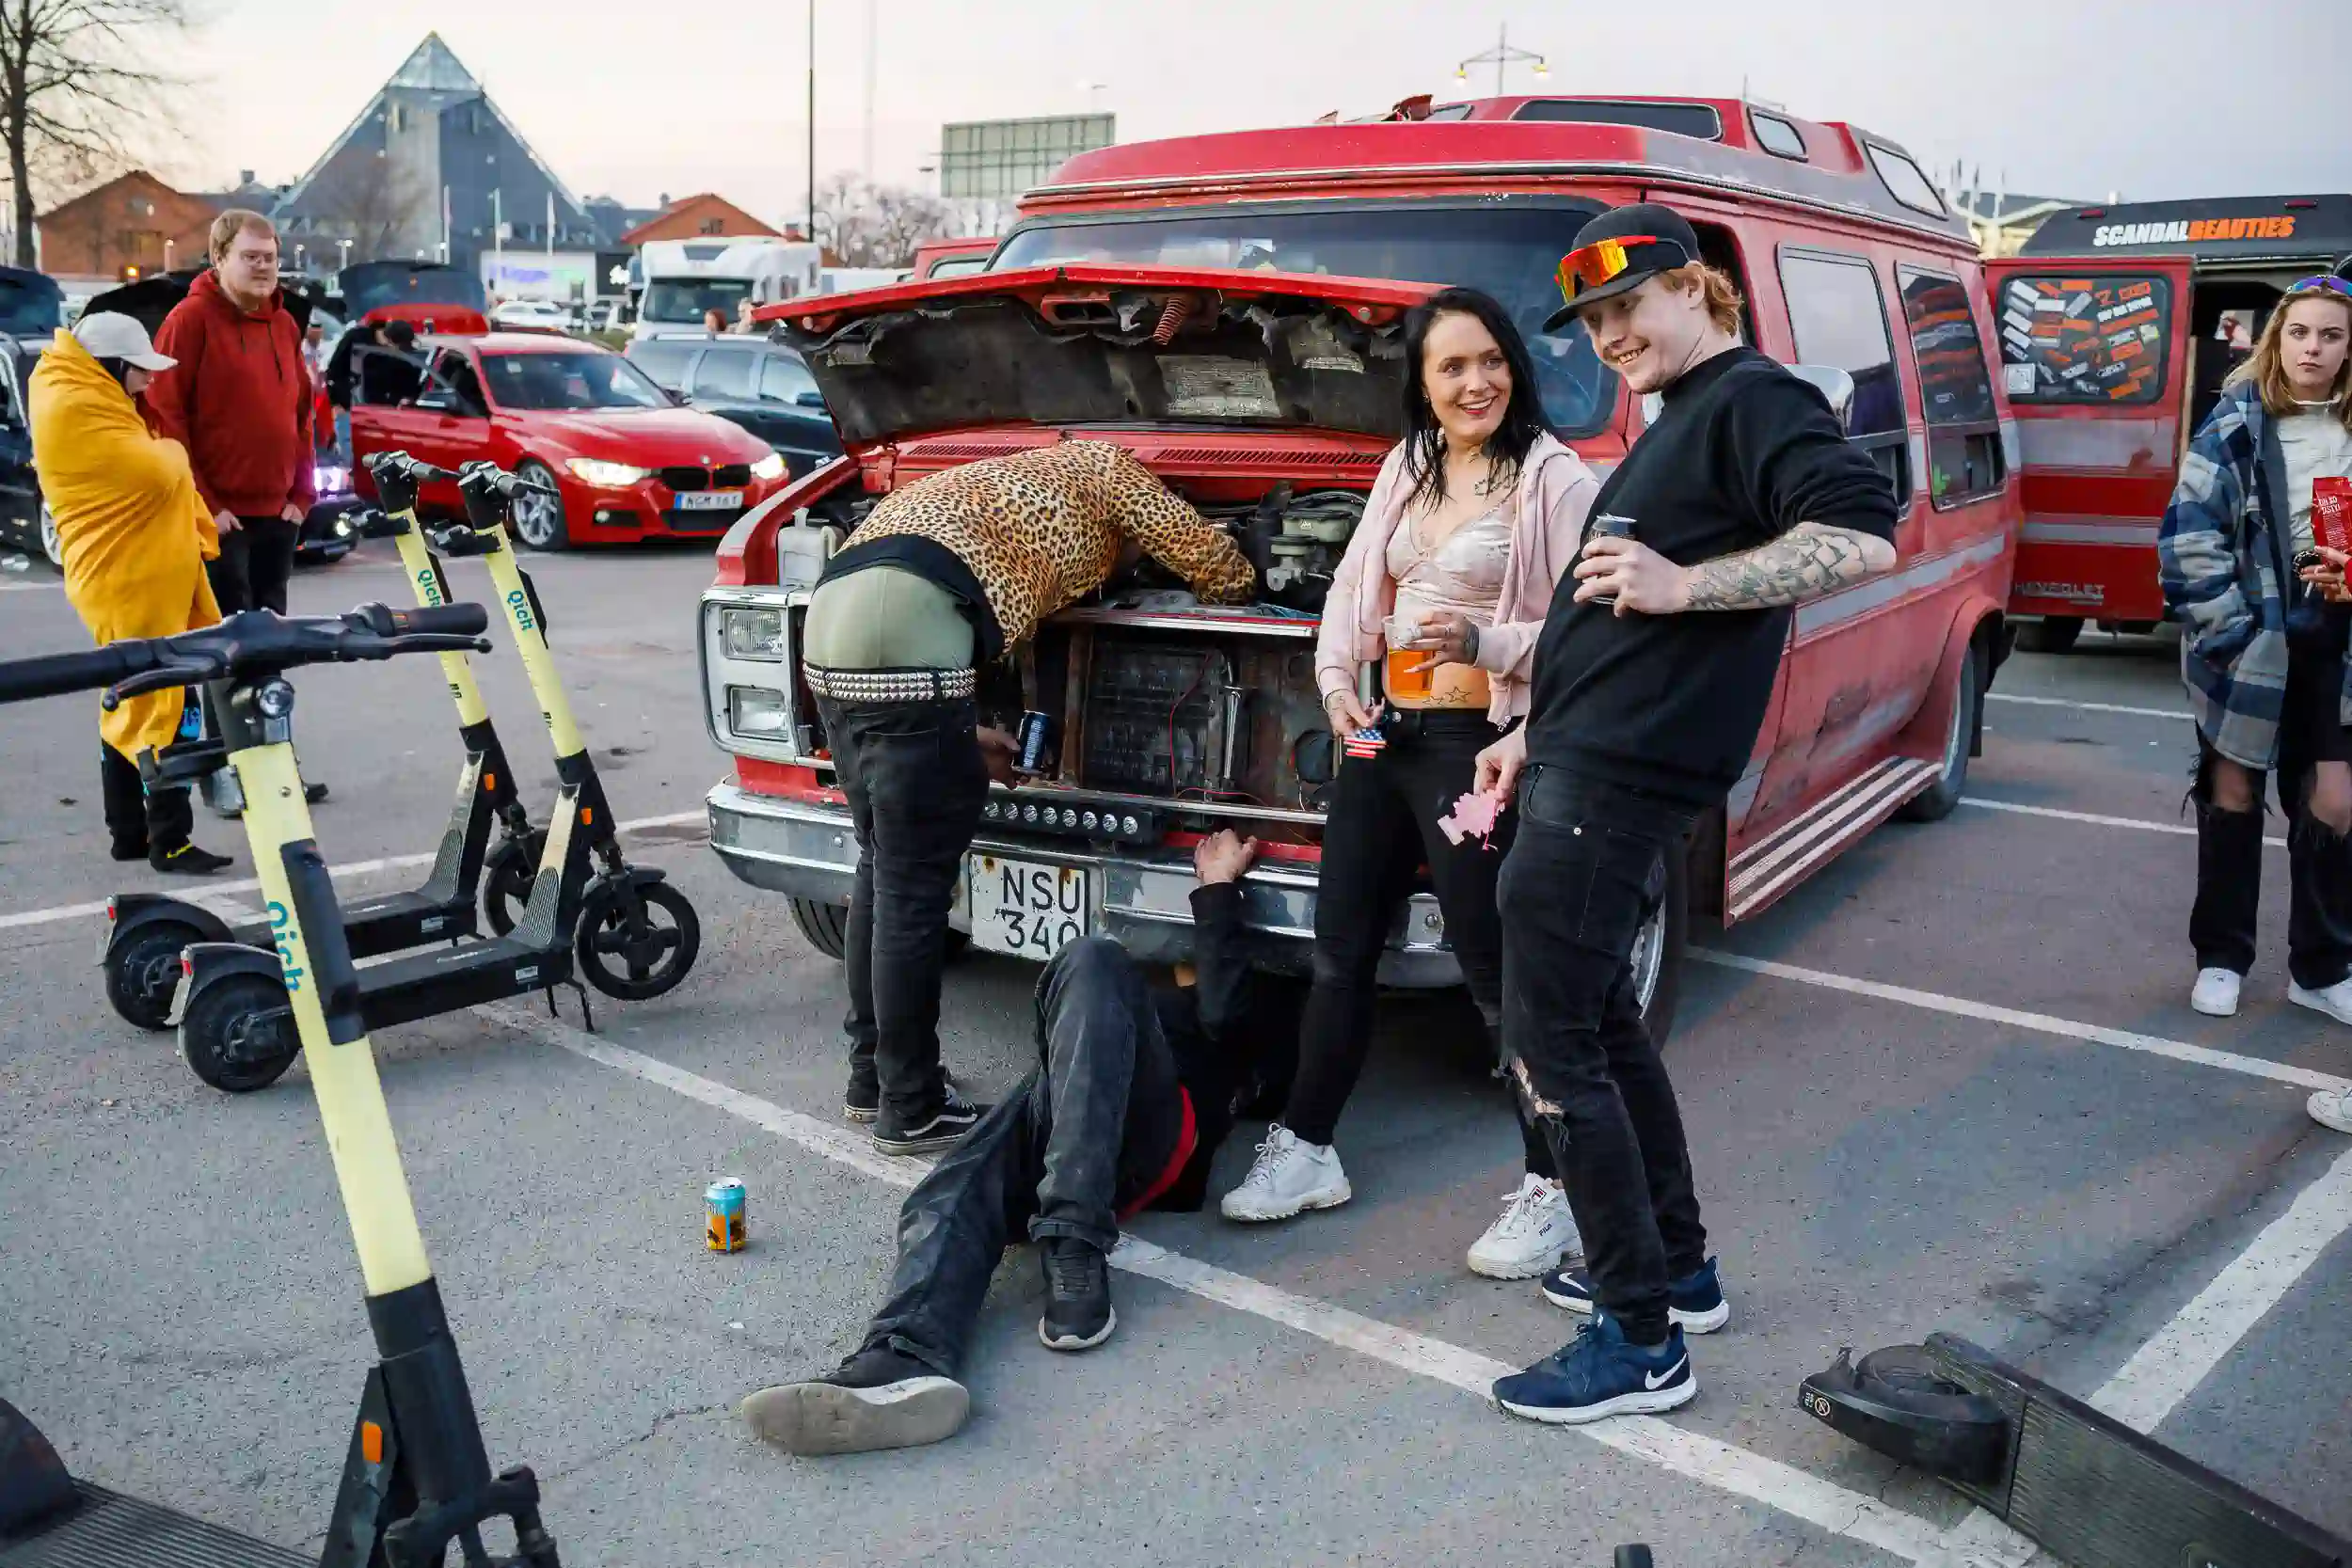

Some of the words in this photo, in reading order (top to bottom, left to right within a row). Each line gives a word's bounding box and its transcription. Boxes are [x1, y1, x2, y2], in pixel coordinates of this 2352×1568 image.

[1003, 864, 1081, 914] NSU
[1001, 908, 1081, 955] 340
[1538, 1223, 1552, 1236] FILA
